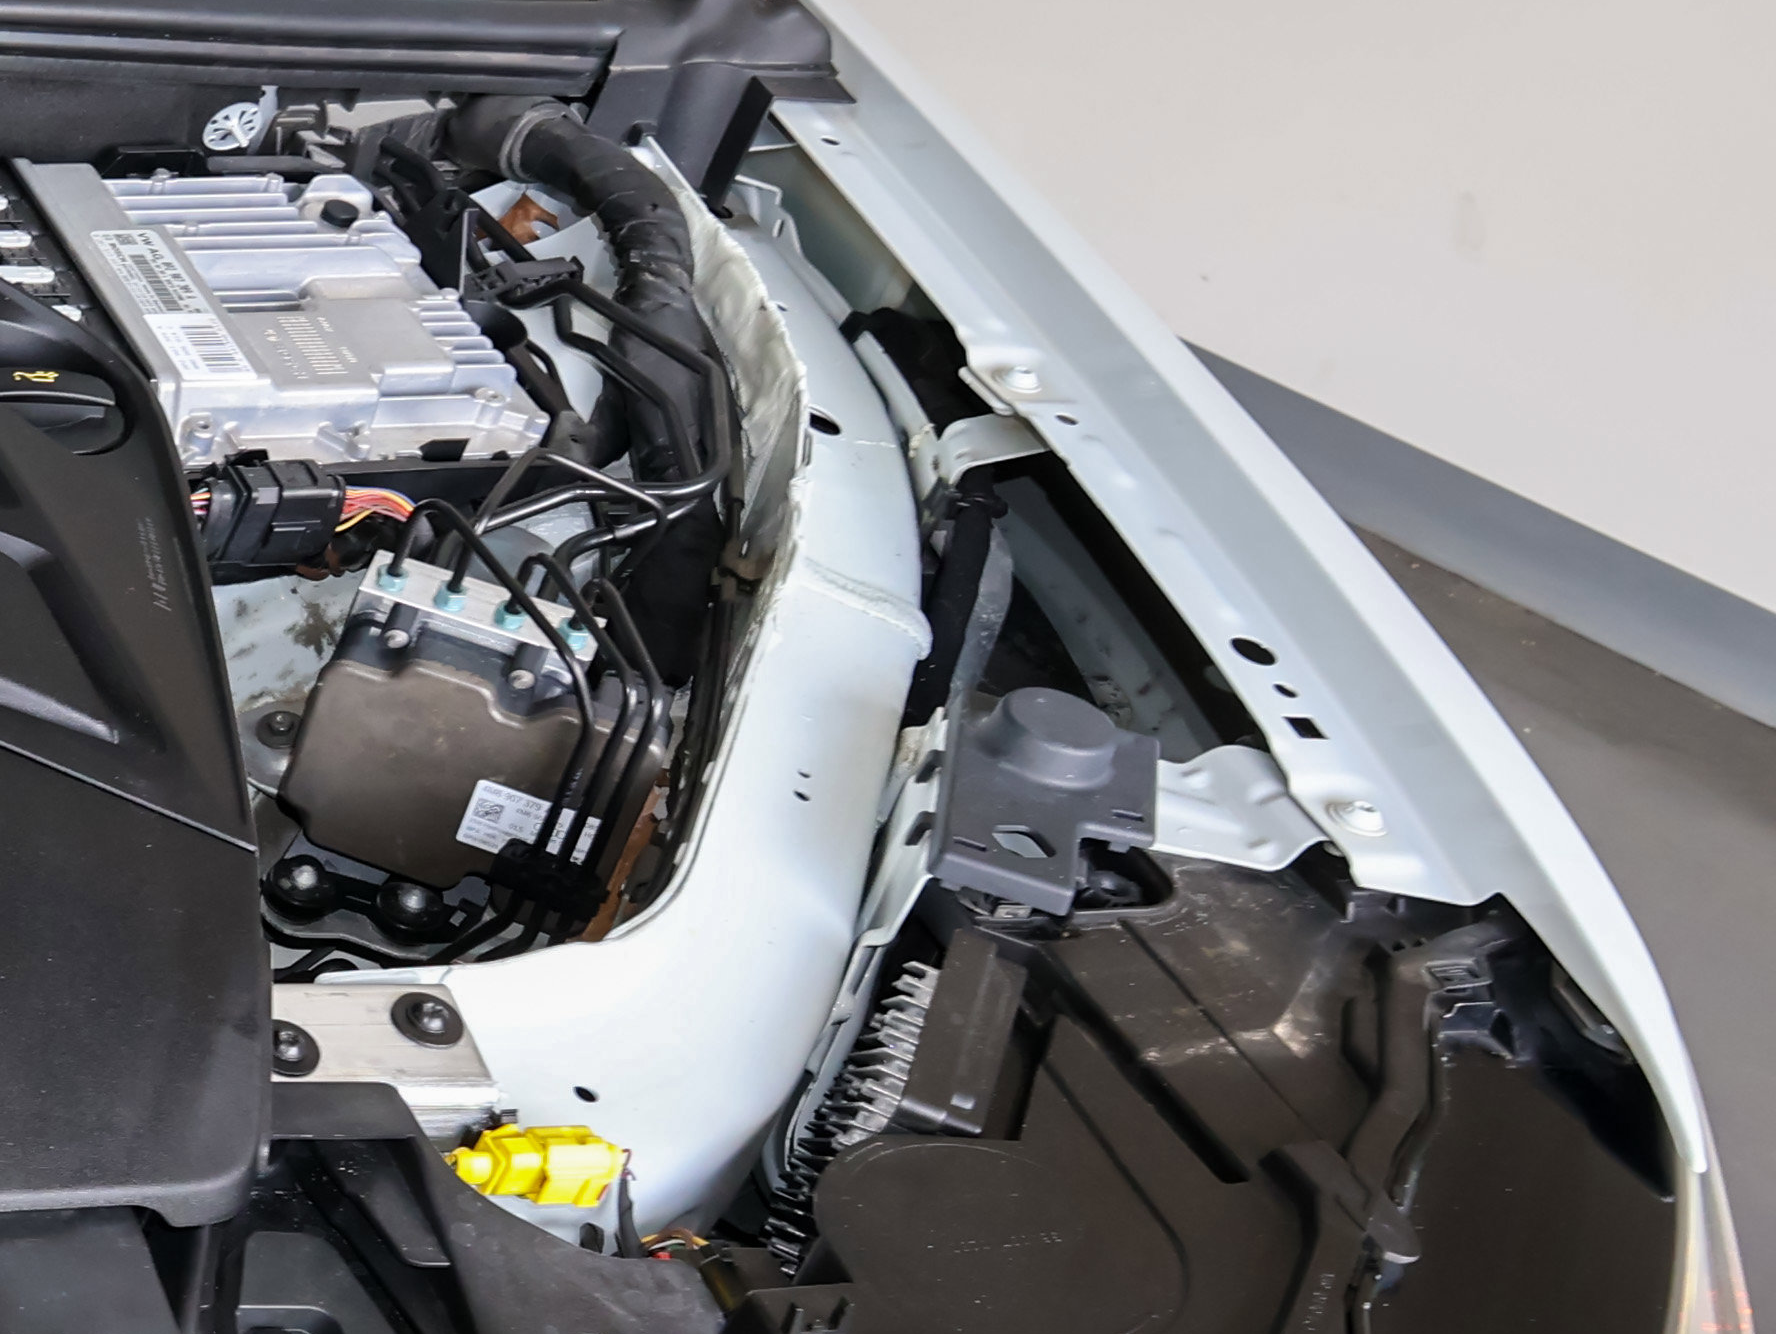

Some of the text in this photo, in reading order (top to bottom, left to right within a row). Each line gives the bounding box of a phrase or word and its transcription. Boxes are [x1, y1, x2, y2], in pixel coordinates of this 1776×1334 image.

[138, 233, 154, 246] VW
[148, 248, 163, 259] AG
[524, 798, 541, 811] 379
